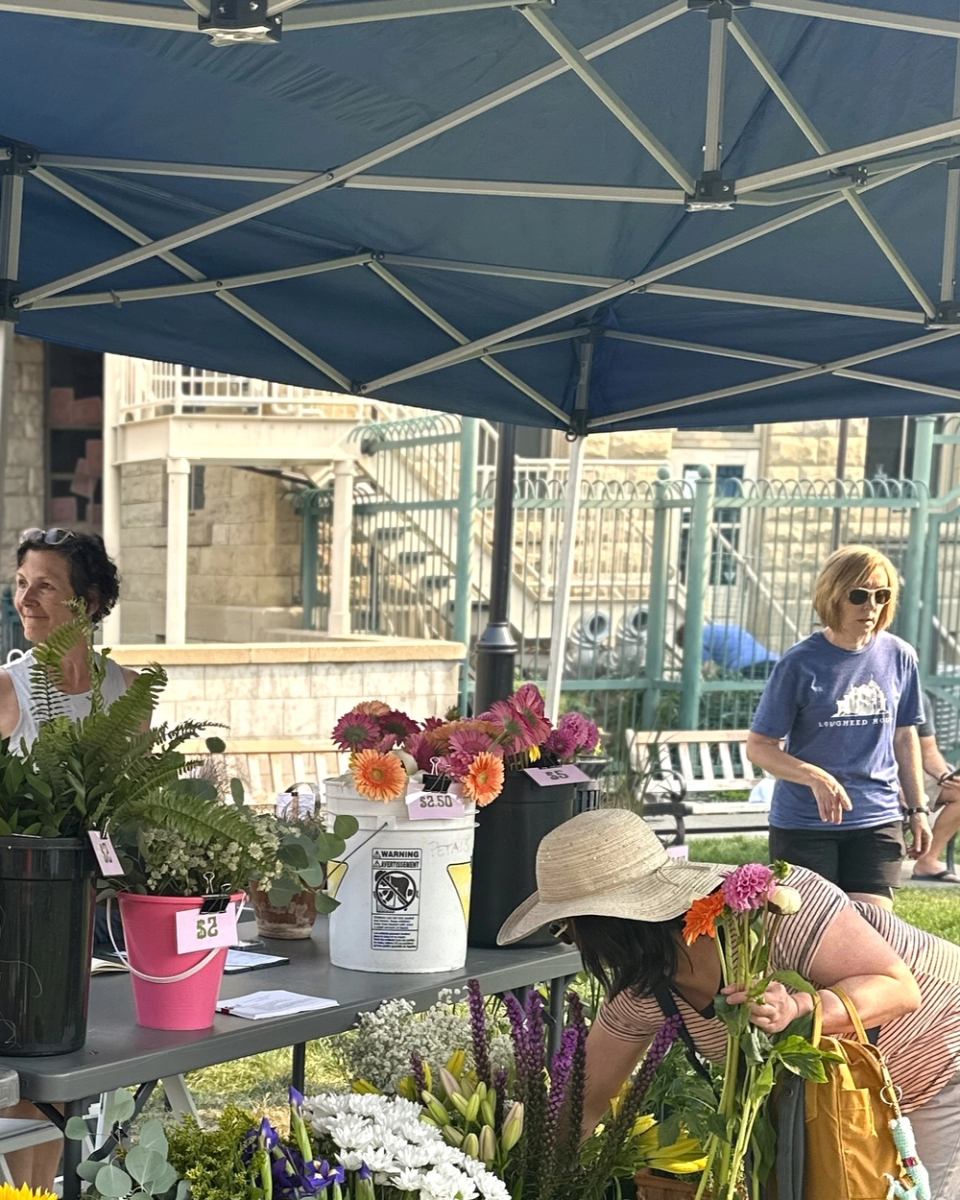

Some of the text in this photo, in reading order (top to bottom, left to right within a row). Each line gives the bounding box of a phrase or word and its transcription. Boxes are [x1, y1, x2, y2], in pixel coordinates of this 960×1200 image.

[818, 720, 868, 728] LOUGHEED
[545, 769, 570, 780] $5
[419, 794, 453, 808] $2.50
[381, 850, 419, 858] WARNING
[196, 916, 219, 939] $2
